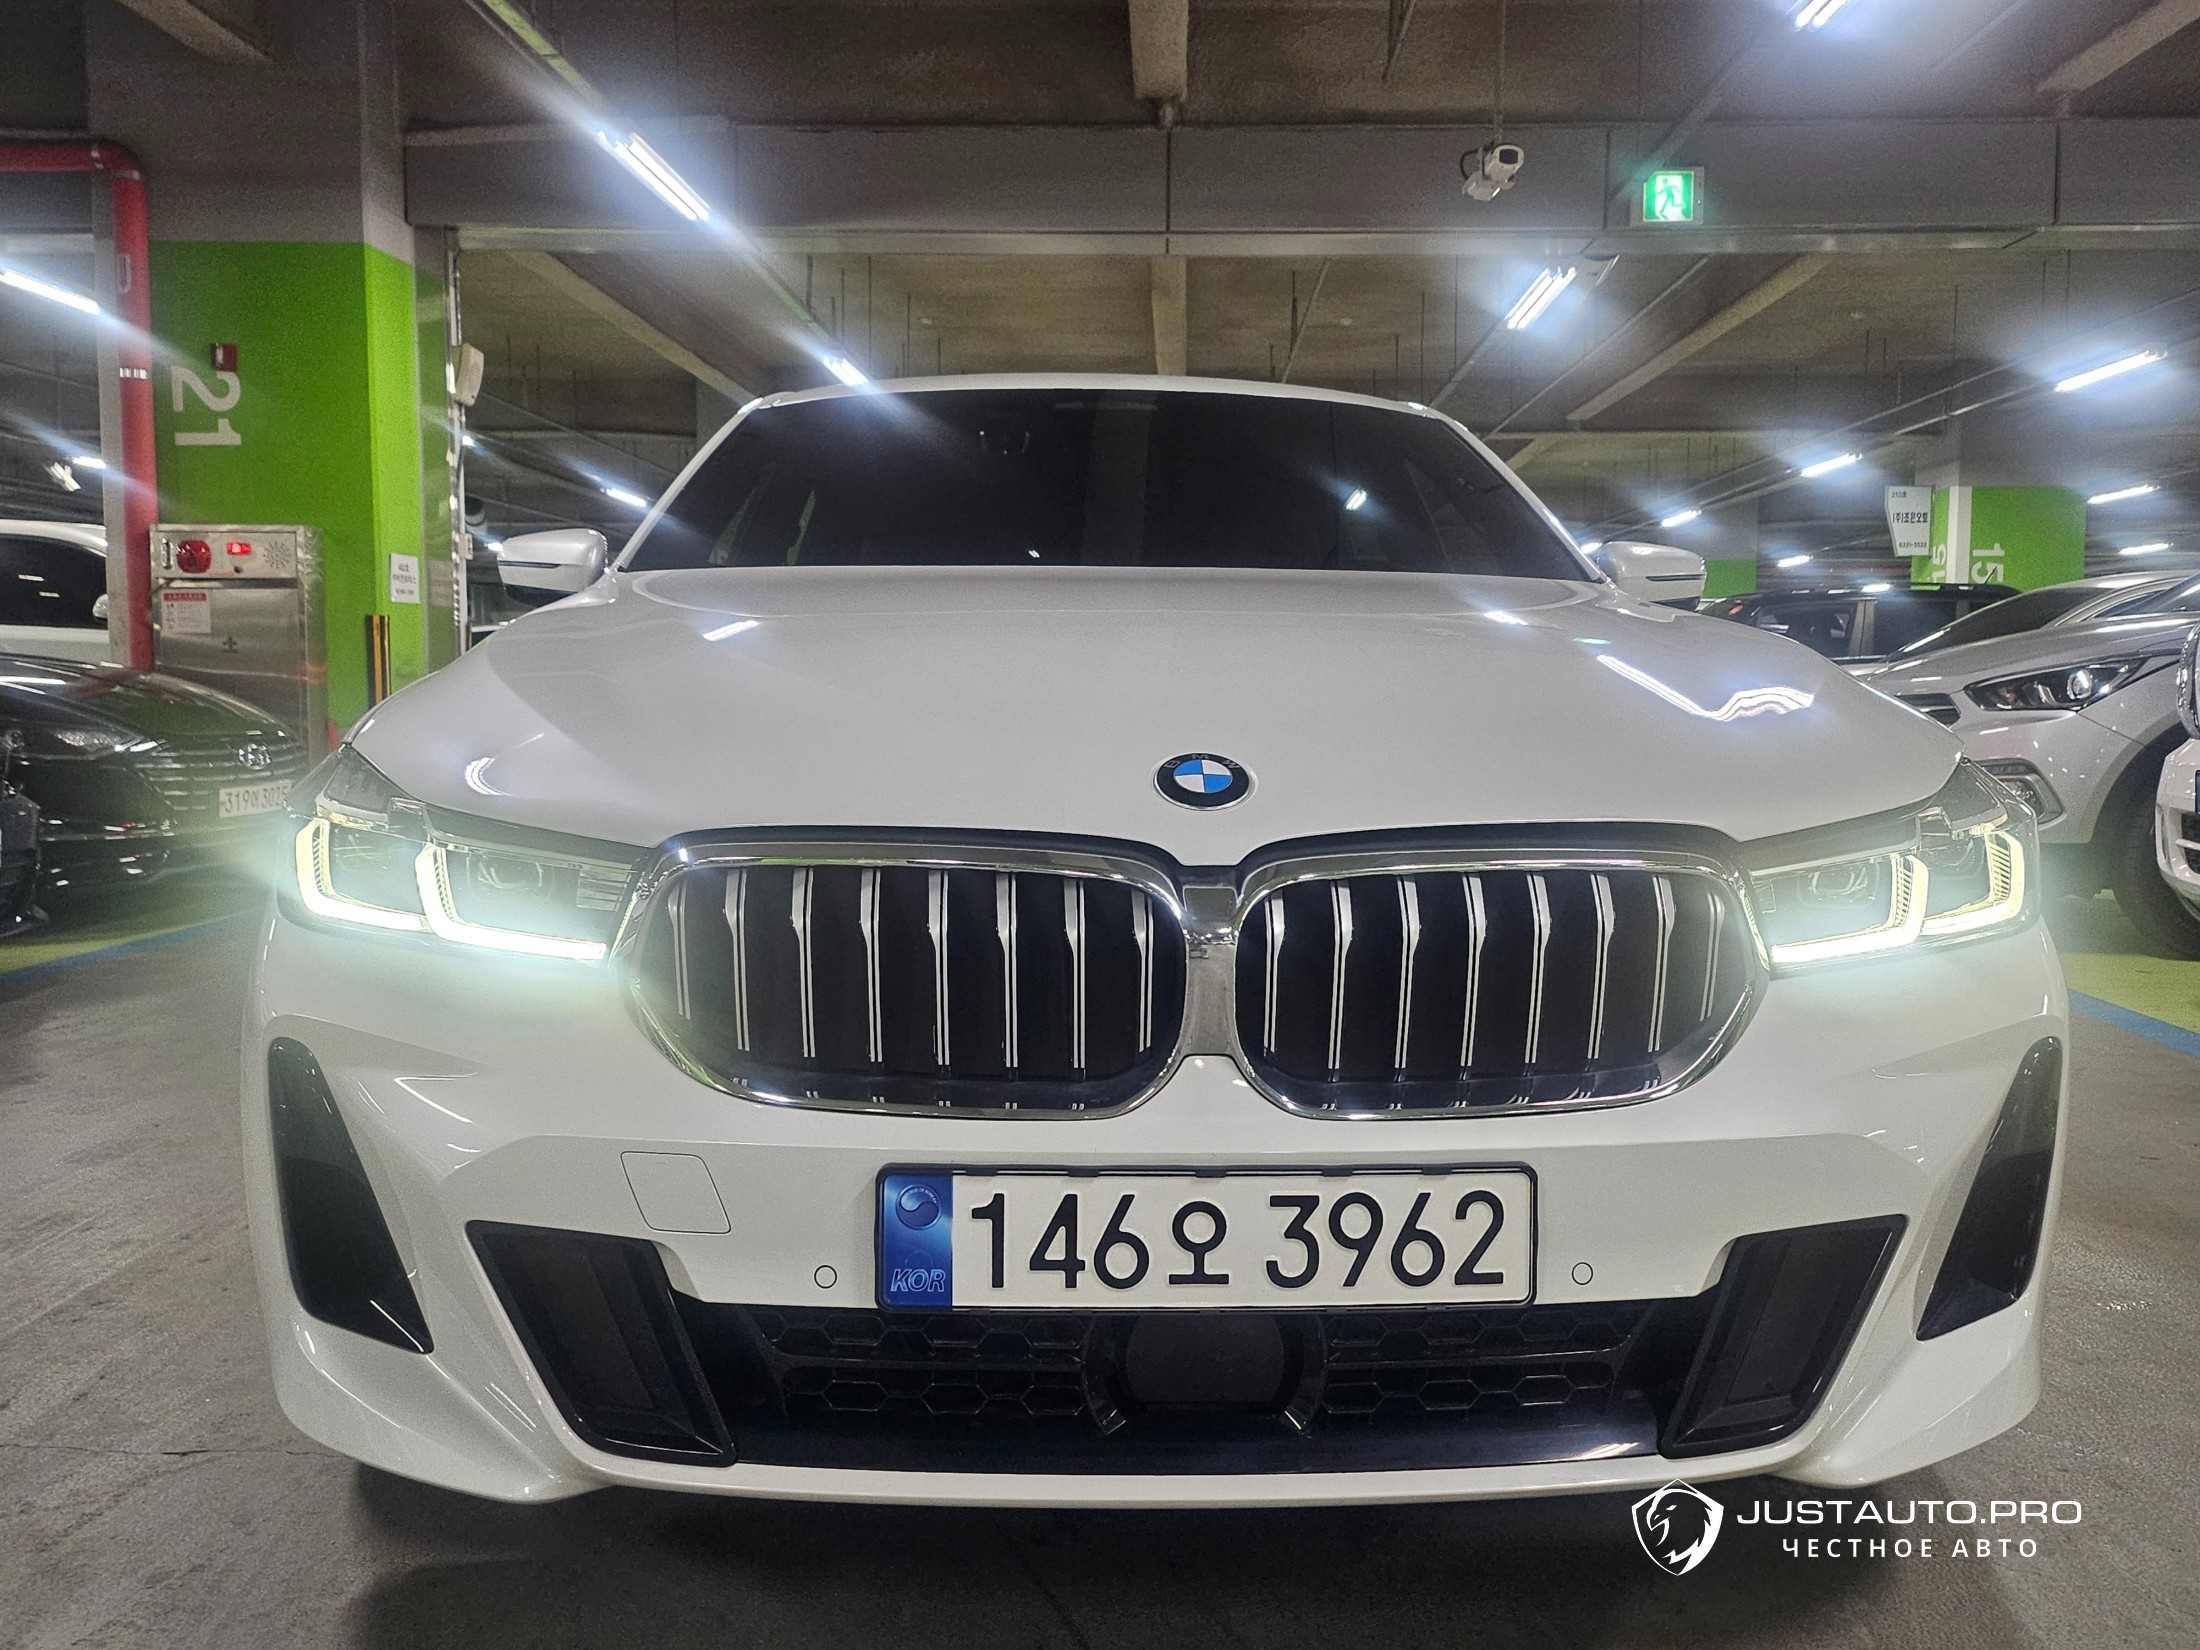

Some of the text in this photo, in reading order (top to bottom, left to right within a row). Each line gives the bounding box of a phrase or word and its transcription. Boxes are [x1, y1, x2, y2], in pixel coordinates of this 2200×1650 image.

[171, 366, 241, 446] 21
[1932, 544, 1946, 583] 15
[1971, 543, 2005, 583] 15
[1163, 754, 1241, 769] BMW
[971, 1190, 1504, 1289] 146오 3962
[890, 1268, 946, 1293] KOR
